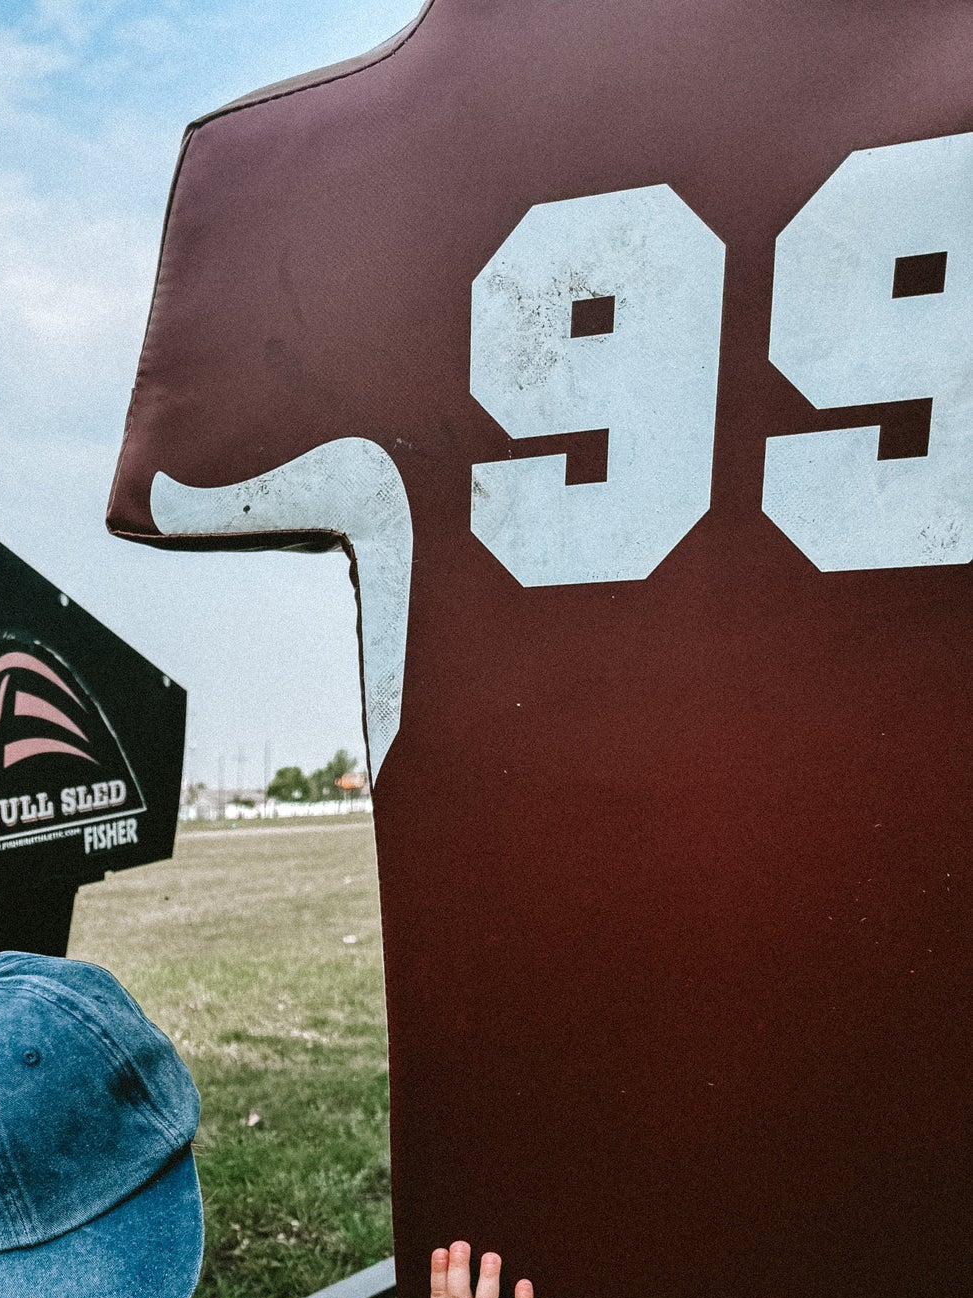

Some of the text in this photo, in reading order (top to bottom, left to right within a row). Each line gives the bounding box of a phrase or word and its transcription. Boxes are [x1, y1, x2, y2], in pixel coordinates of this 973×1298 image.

[470, 131, 973, 588] 99
[60, 779, 127, 817] SLED
[83, 817, 139, 855] FISHER
